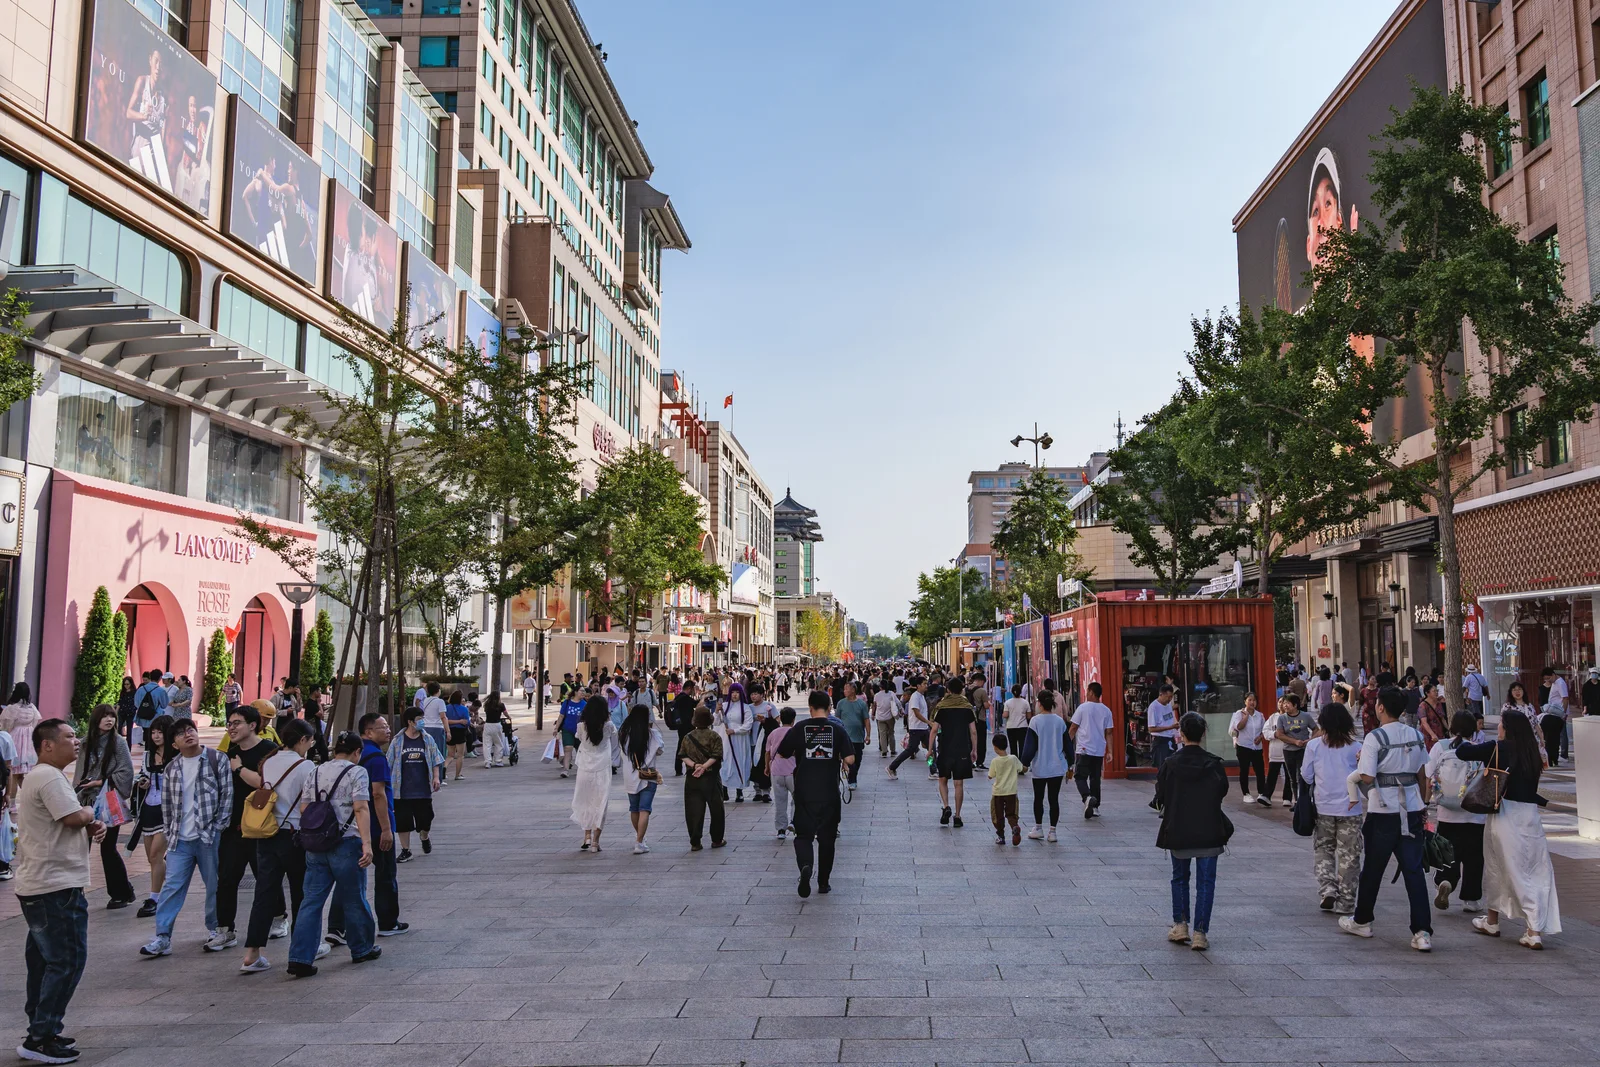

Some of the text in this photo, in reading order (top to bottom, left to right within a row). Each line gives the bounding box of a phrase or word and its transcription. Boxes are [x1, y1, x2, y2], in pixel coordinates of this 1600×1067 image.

[100, 54, 126, 83] YOU
[268, 184, 285, 204] GOT
[378, 265, 394, 284] THIS
[174, 532, 243, 564] LANCÔME
[197, 590, 231, 614] ROSE
[401, 747, 425, 755] SKECHER
